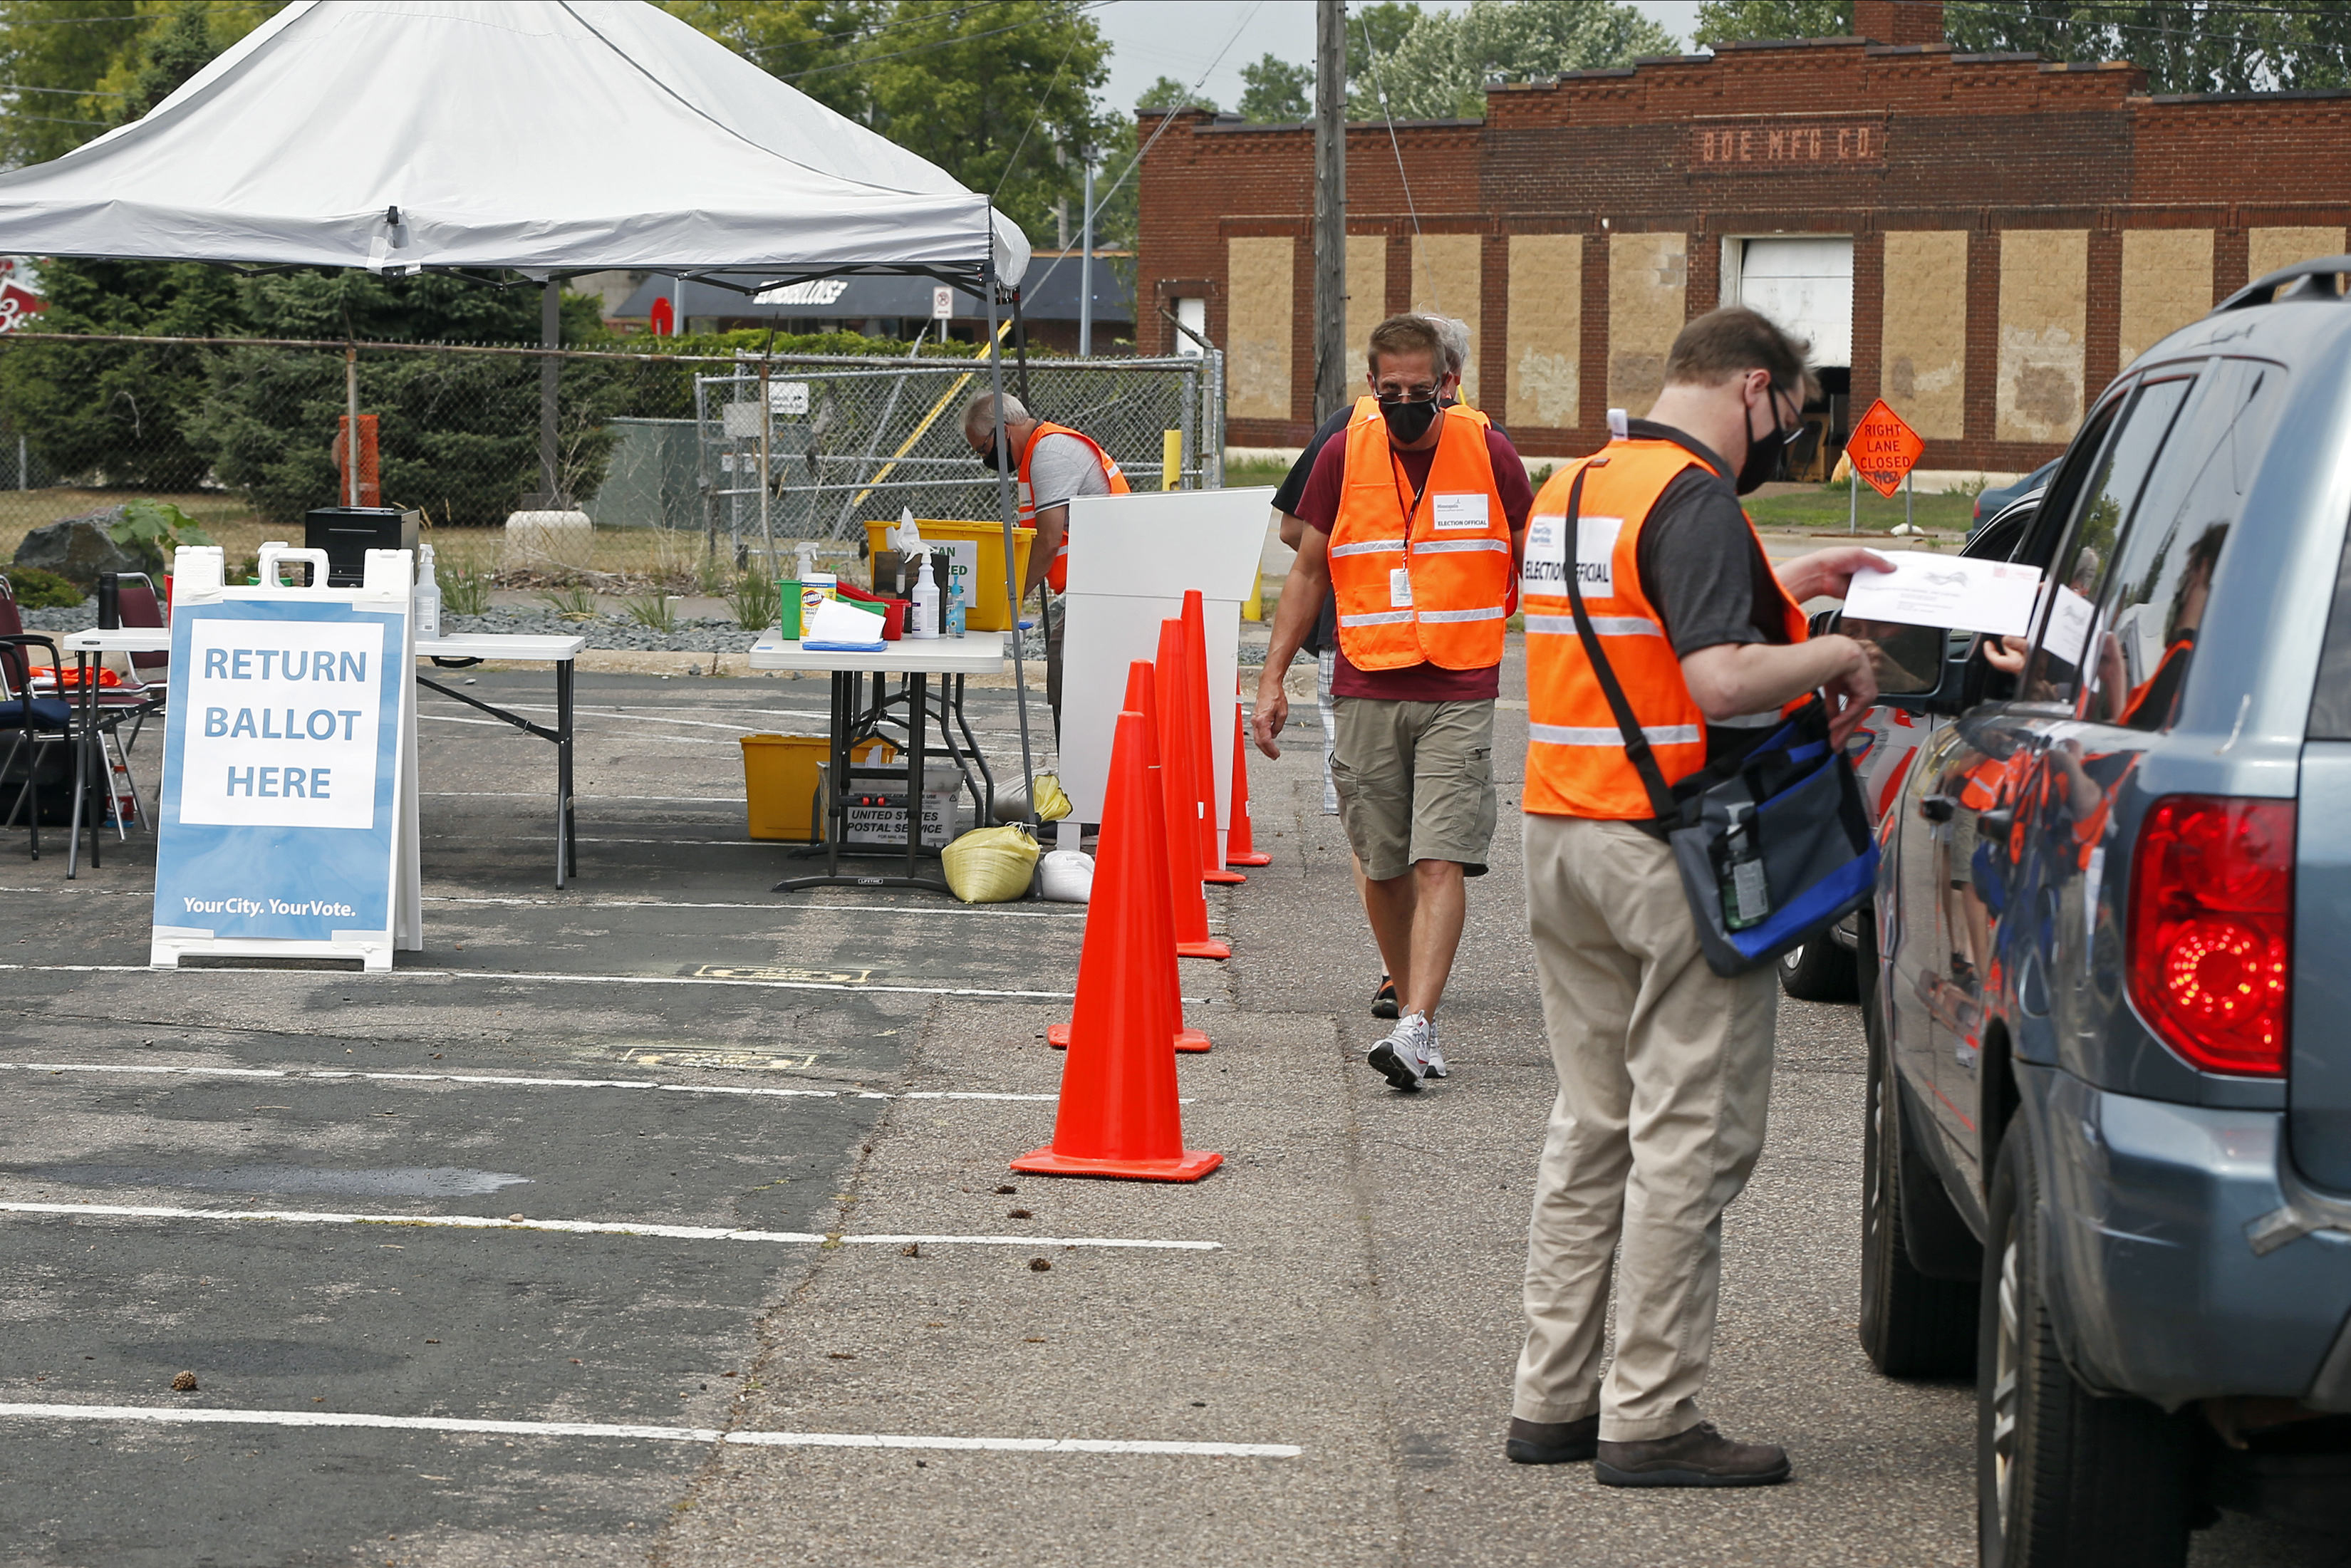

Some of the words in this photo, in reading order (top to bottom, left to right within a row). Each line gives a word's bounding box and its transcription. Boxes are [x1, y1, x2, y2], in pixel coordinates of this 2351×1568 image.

[1703, 131, 1751, 161] BOE
[1839, 128, 1874, 157] CO.
[1865, 424, 1901, 436] RIGHT
[1867, 440, 1900, 452] LANE
[1860, 456, 1911, 469] CLOSED
[1575, 562, 1609, 582] FFICIAL
[802, 593, 822, 604] CLOROX
[204, 648, 366, 682] RETURN
[204, 707, 362, 741] BALLOT
[227, 766, 331, 799] HERE
[851, 810, 893, 820] UNITED
[895, 811, 938, 821] STES
[848, 822, 891, 832] POSTAL
[894, 824, 943, 834] SEICE
